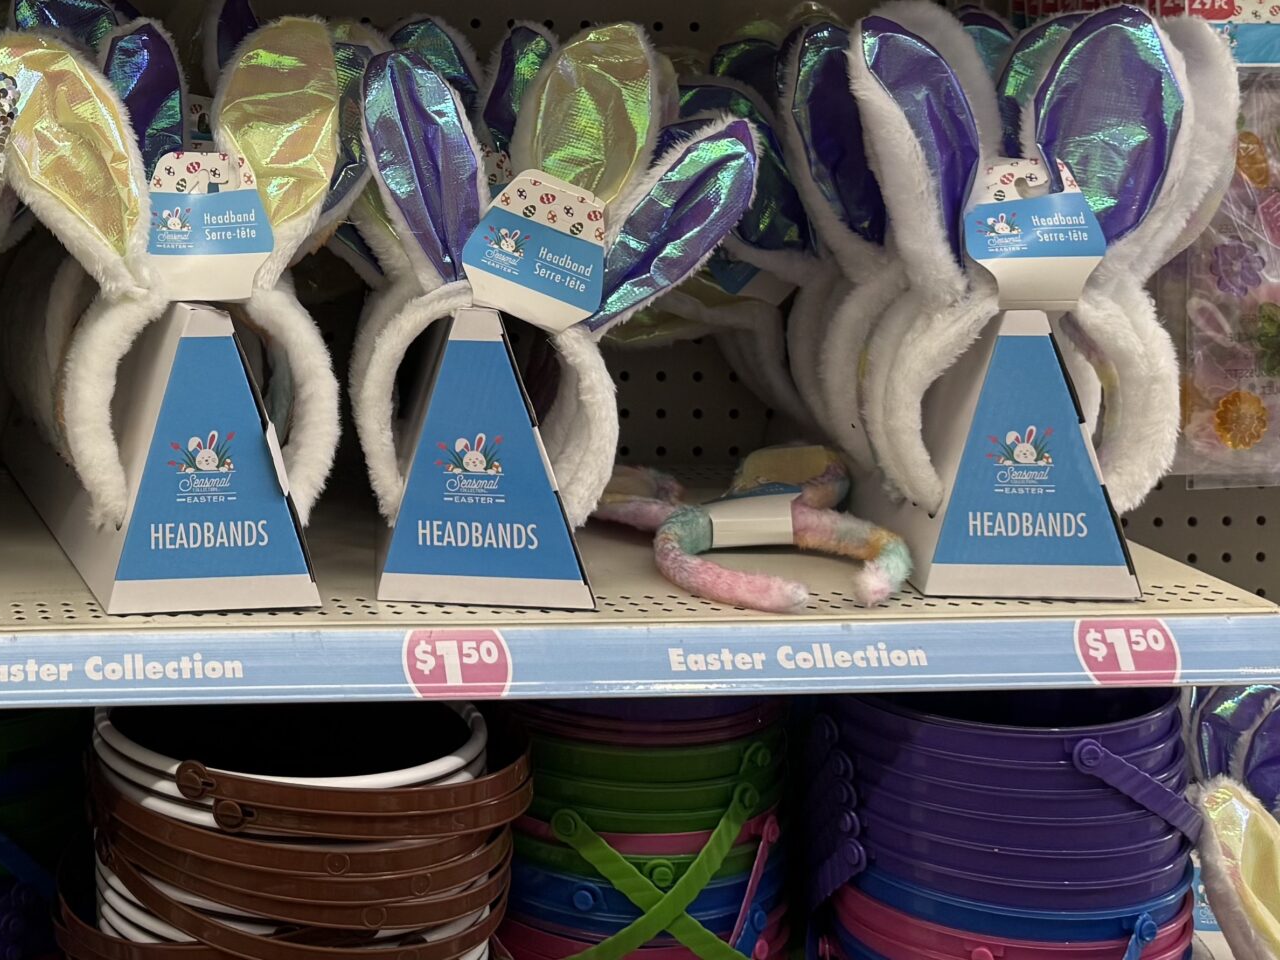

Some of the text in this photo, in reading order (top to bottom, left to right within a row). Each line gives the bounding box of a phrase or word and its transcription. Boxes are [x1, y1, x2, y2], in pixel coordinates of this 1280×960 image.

[204, 209, 255, 225] Headband
[1031, 211, 1085, 226] Headband
[205, 227, 256, 241] Serre-tête
[1036, 229, 1088, 242] Serre-tête
[539, 246, 593, 277] Headband
[533, 262, 586, 292] Serre-tête
[179, 473, 231, 492] Seasonal
[446, 474, 500, 492] Seasonal
[996, 466, 1050, 483] Seasonal
[454, 496, 494, 504] EASTER
[1004, 487, 1044, 495] EASTER
[968, 511, 1088, 538] HEADBANDS
[150, 520, 269, 550] HEADBANDS
[417, 520, 539, 550] HEADBANDS
[668, 642, 928, 672] Easter Collection
[84, 652, 244, 681] Collection
